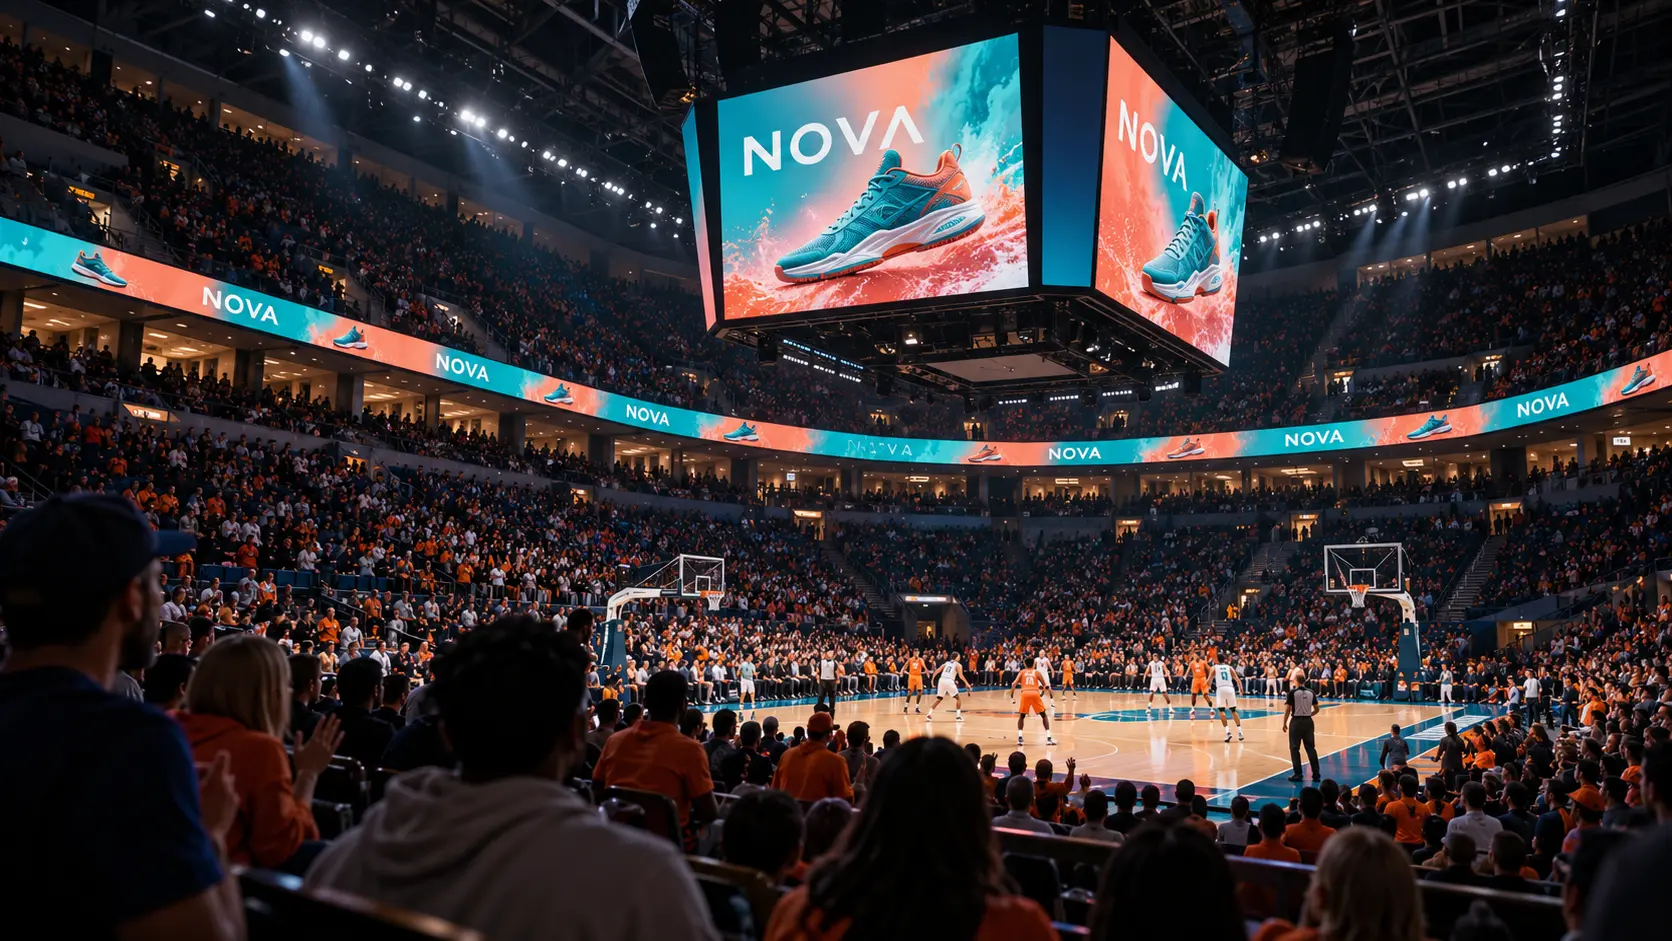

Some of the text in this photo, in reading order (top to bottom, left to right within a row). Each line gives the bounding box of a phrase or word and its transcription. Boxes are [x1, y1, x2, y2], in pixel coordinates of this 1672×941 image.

[743, 105, 925, 176] NOVA
[1118, 99, 1188, 192] NOVA
[202, 286, 279, 326] NOVA
[436, 352, 490, 382] NOVA
[626, 403, 670, 426] NOVA
[1517, 391, 1570, 418] NOVA
[1285, 429, 1345, 447] NOVA
[1048, 446, 1102, 460] NOVA
